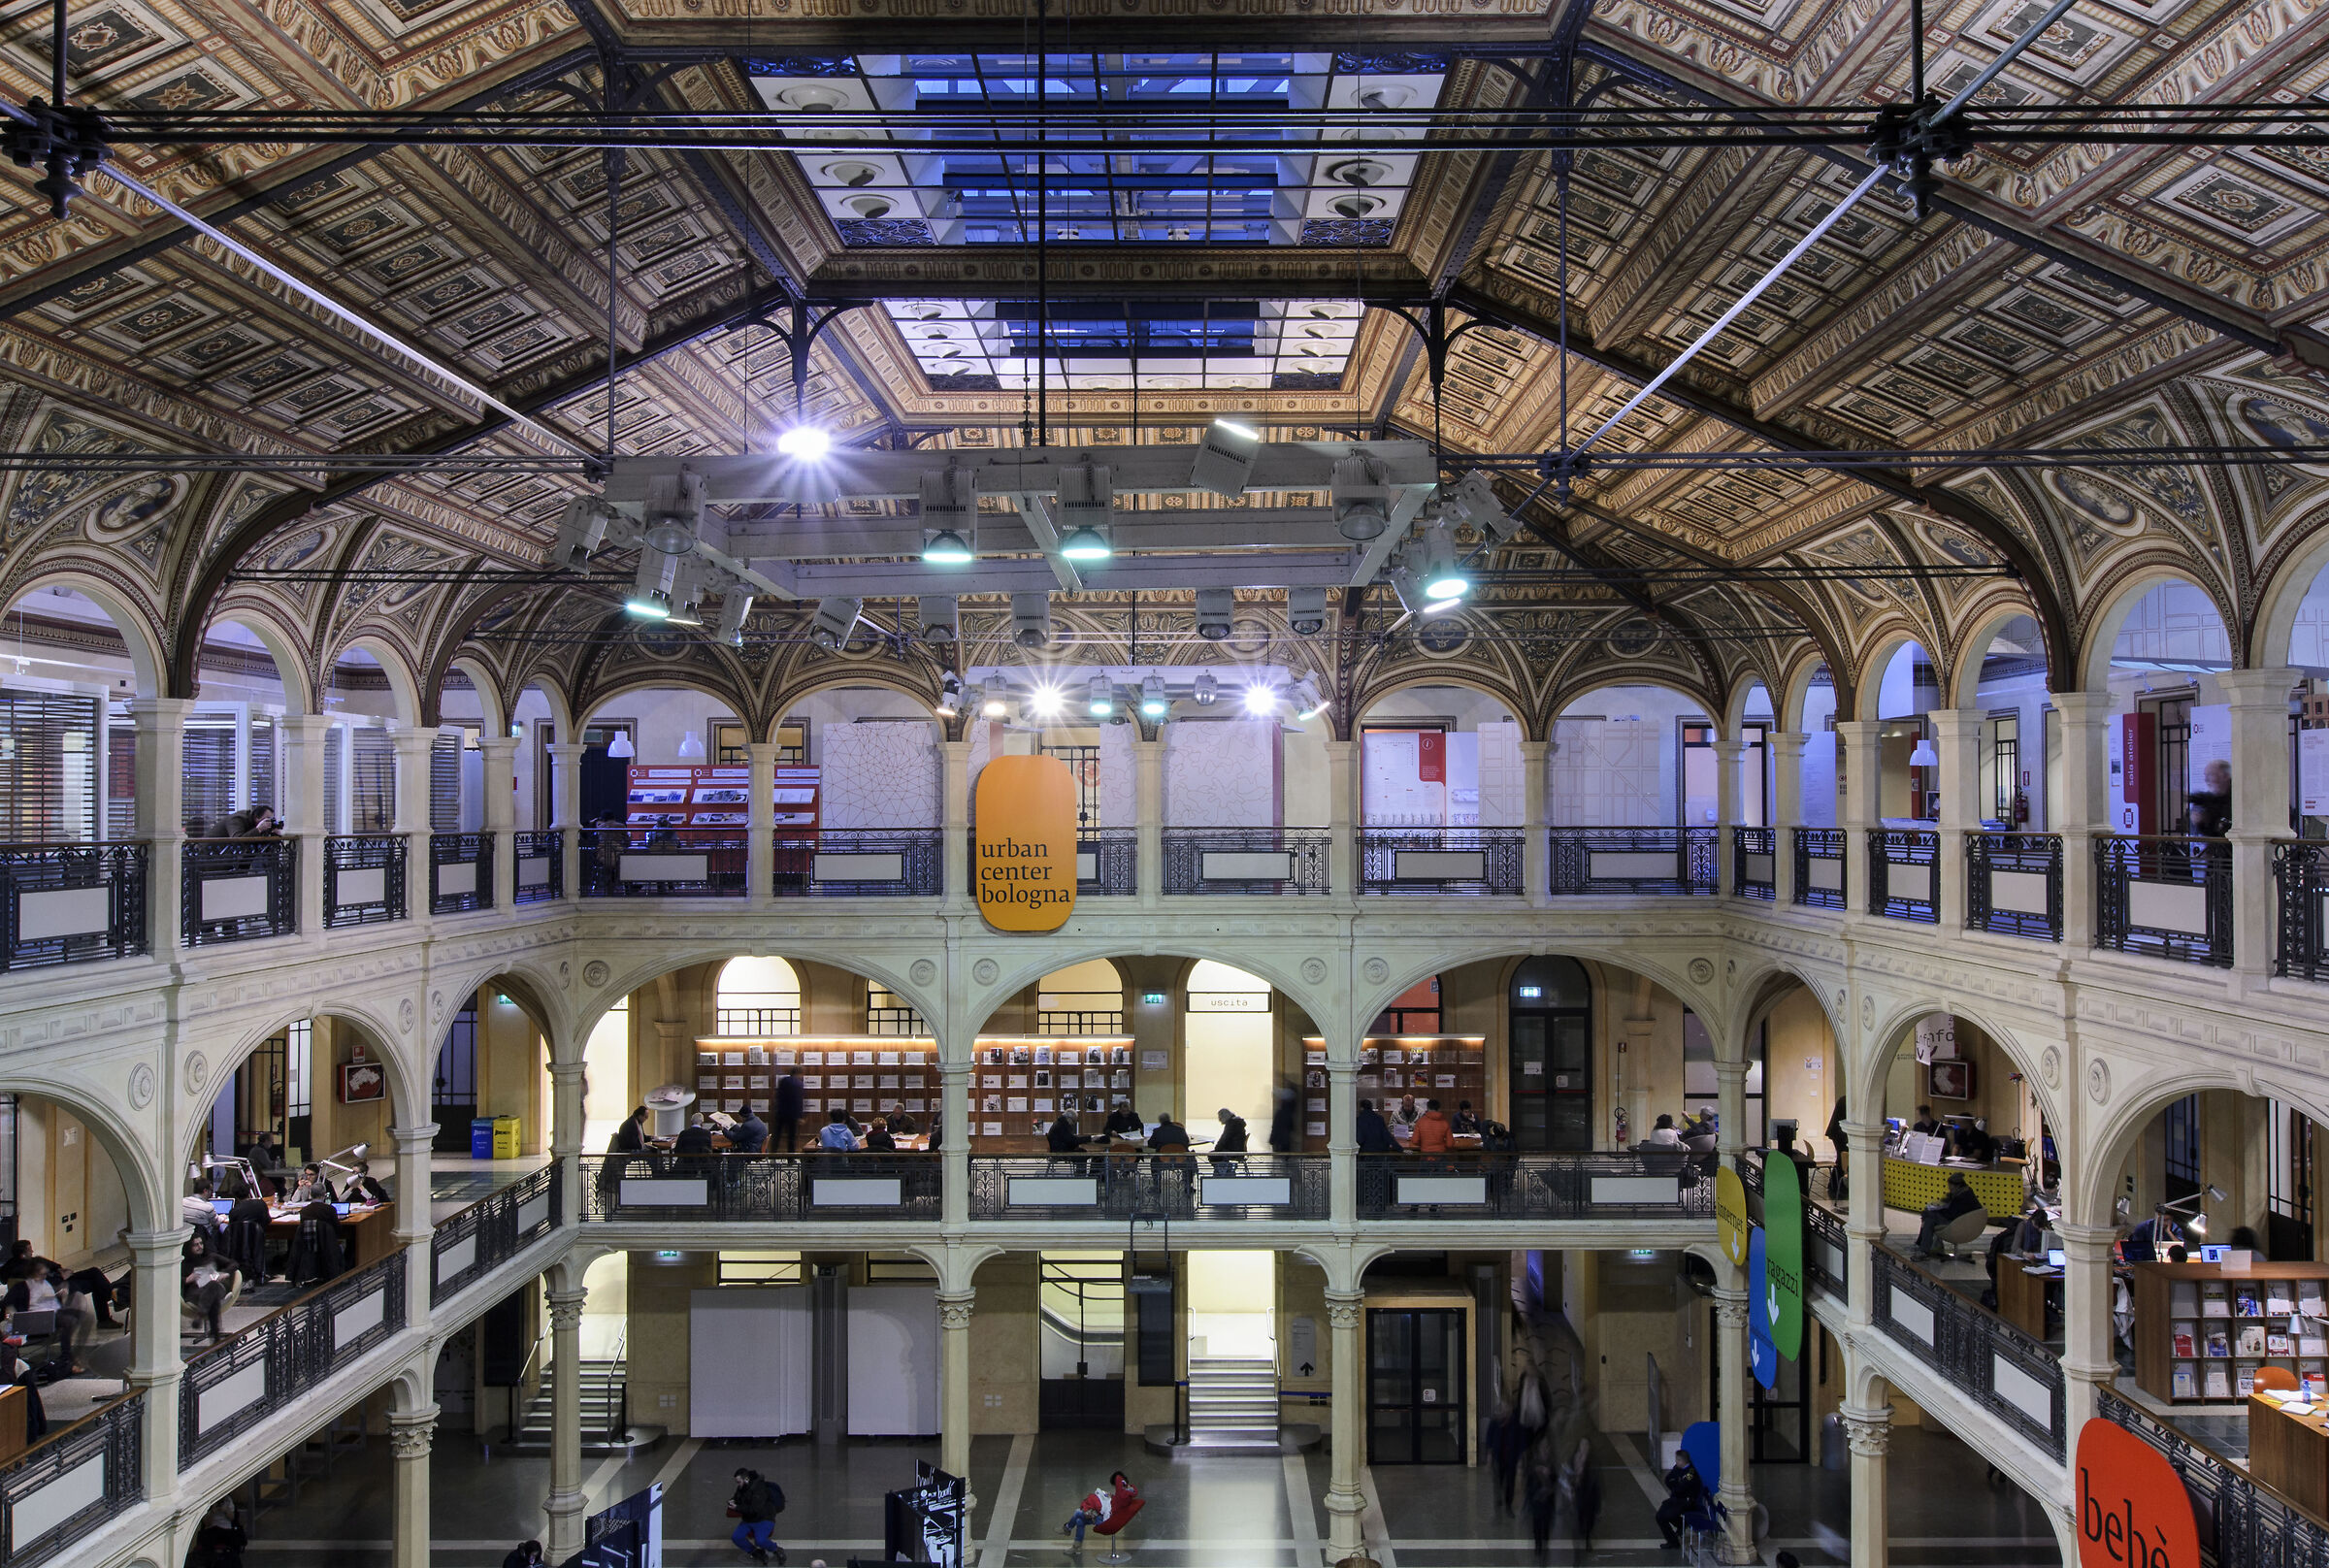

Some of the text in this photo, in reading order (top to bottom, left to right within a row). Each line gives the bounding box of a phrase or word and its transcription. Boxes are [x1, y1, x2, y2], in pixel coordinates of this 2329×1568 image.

[980, 837, 1049, 858] urban
[980, 864, 1053, 881] center
[980, 883, 1071, 910] bologna
[1929, 1029, 1954, 1042] nfo
[1717, 1196, 1744, 1235] internet
[1766, 1257, 1799, 1298] ragazzi
[2081, 1467, 2171, 1568] bebè
